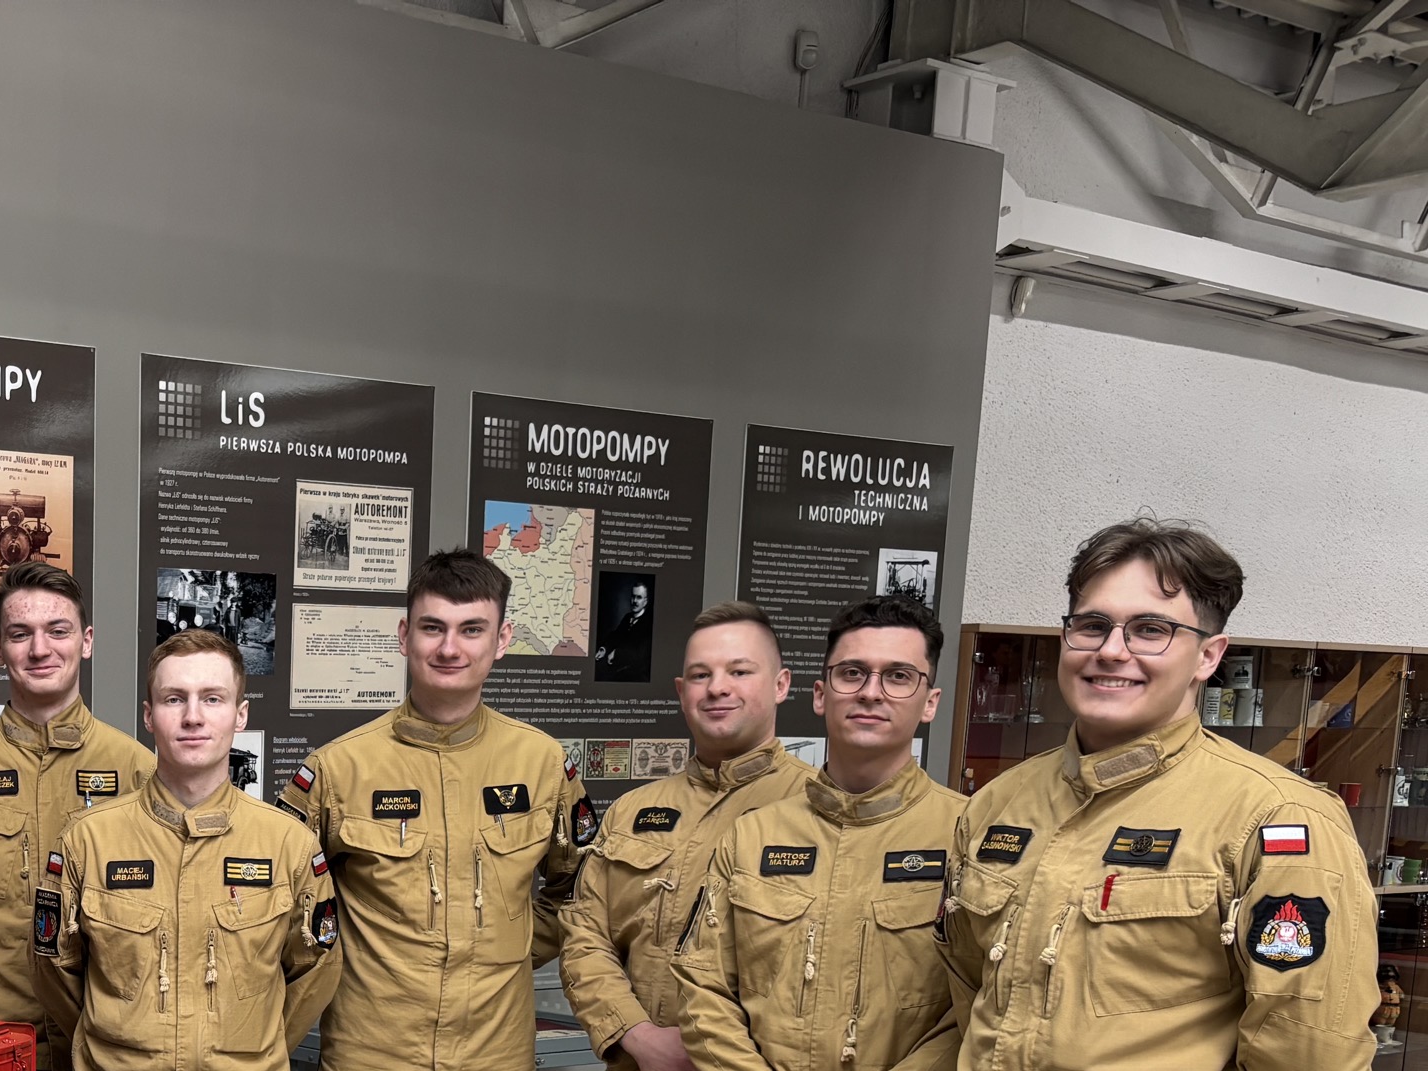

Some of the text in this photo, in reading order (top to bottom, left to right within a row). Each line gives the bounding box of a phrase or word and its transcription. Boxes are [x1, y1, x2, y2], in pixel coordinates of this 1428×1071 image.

[220, 436, 408, 465] PIERWSZA POLSKA MOTOPOMPA
[527, 422, 670, 466] MOTOPOMPY
[527, 462, 641, 483] W DZIELE MOTORYZACJI
[801, 450, 931, 489] REWOLUCJA
[300, 488, 321, 496] Pierwsza
[527, 477, 670, 501] POLSKICH STRAŻY POŻARNYCH
[354, 503, 408, 519] AUTOREMONT
[854, 490, 928, 512] TECHNICZNA
[799, 505, 885, 527] I MOTOPOMPY
[375, 803, 418, 811] JACKOWSKI
[381, 796, 411, 804] MARCIN
[768, 852, 810, 861] BARTOSZ
[112, 873, 149, 881] URBAŃSKI
